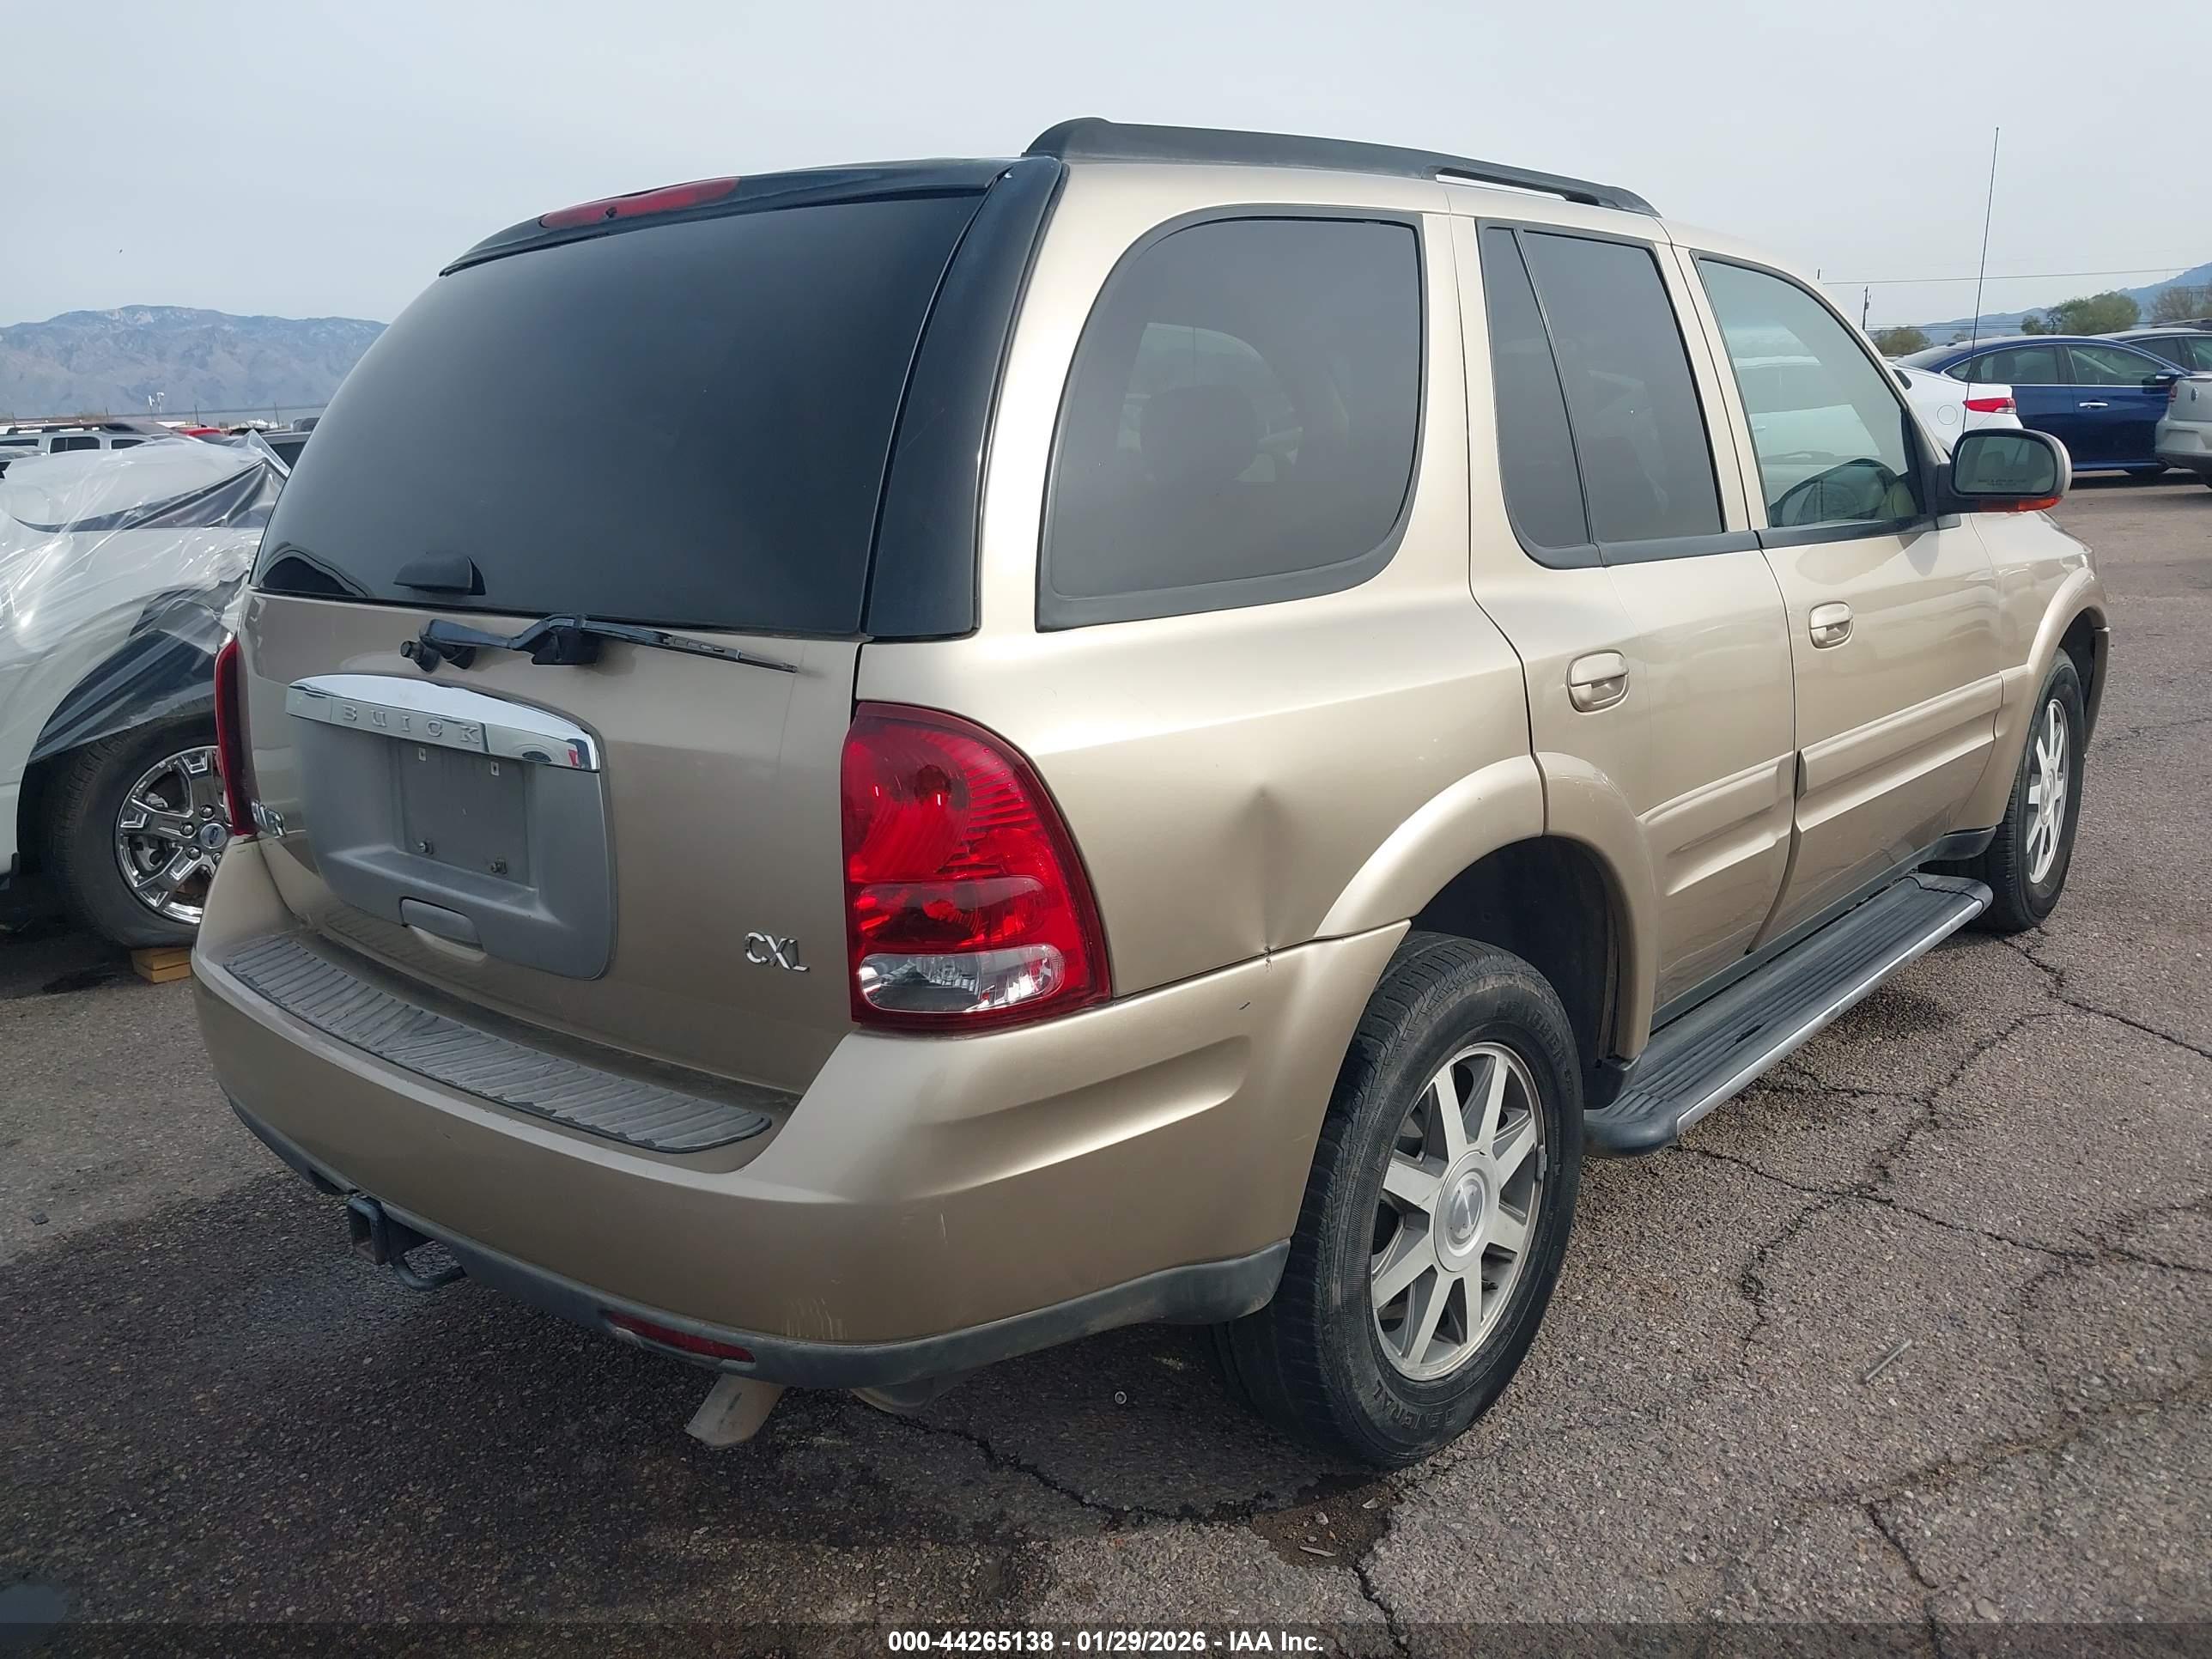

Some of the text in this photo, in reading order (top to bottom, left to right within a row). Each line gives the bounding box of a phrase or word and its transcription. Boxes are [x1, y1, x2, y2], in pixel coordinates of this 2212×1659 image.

[342, 703, 480, 744] BUICK
[744, 931, 810, 972] CXL
[1373, 1379, 1457, 1430] GENERAL
